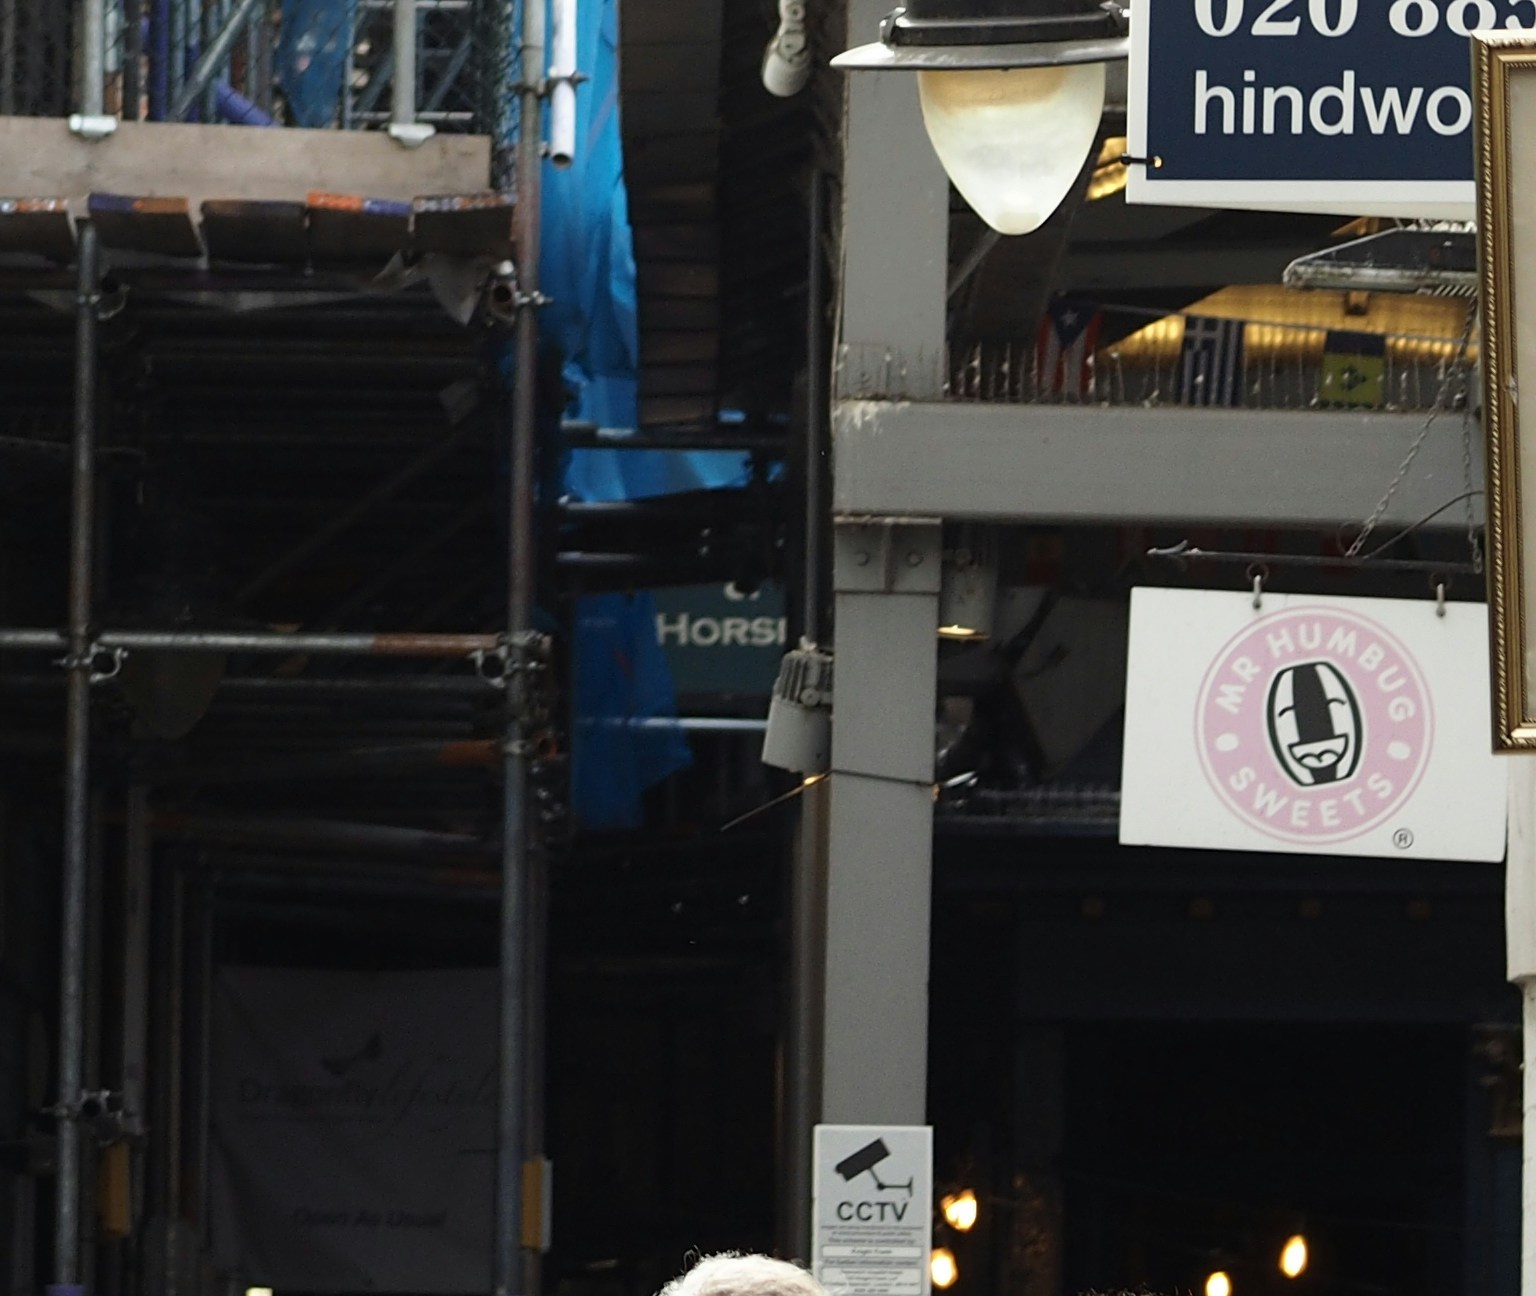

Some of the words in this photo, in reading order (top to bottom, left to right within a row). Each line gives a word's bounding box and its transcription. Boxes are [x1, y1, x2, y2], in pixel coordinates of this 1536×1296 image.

[1194, 70, 1472, 137] hindwo
[1213, 655, 1262, 715] MR
[1266, 621, 1416, 723] HUMBUG
[1228, 765, 1395, 829] SWEETS
[836, 1200, 909, 1223] CCTV
